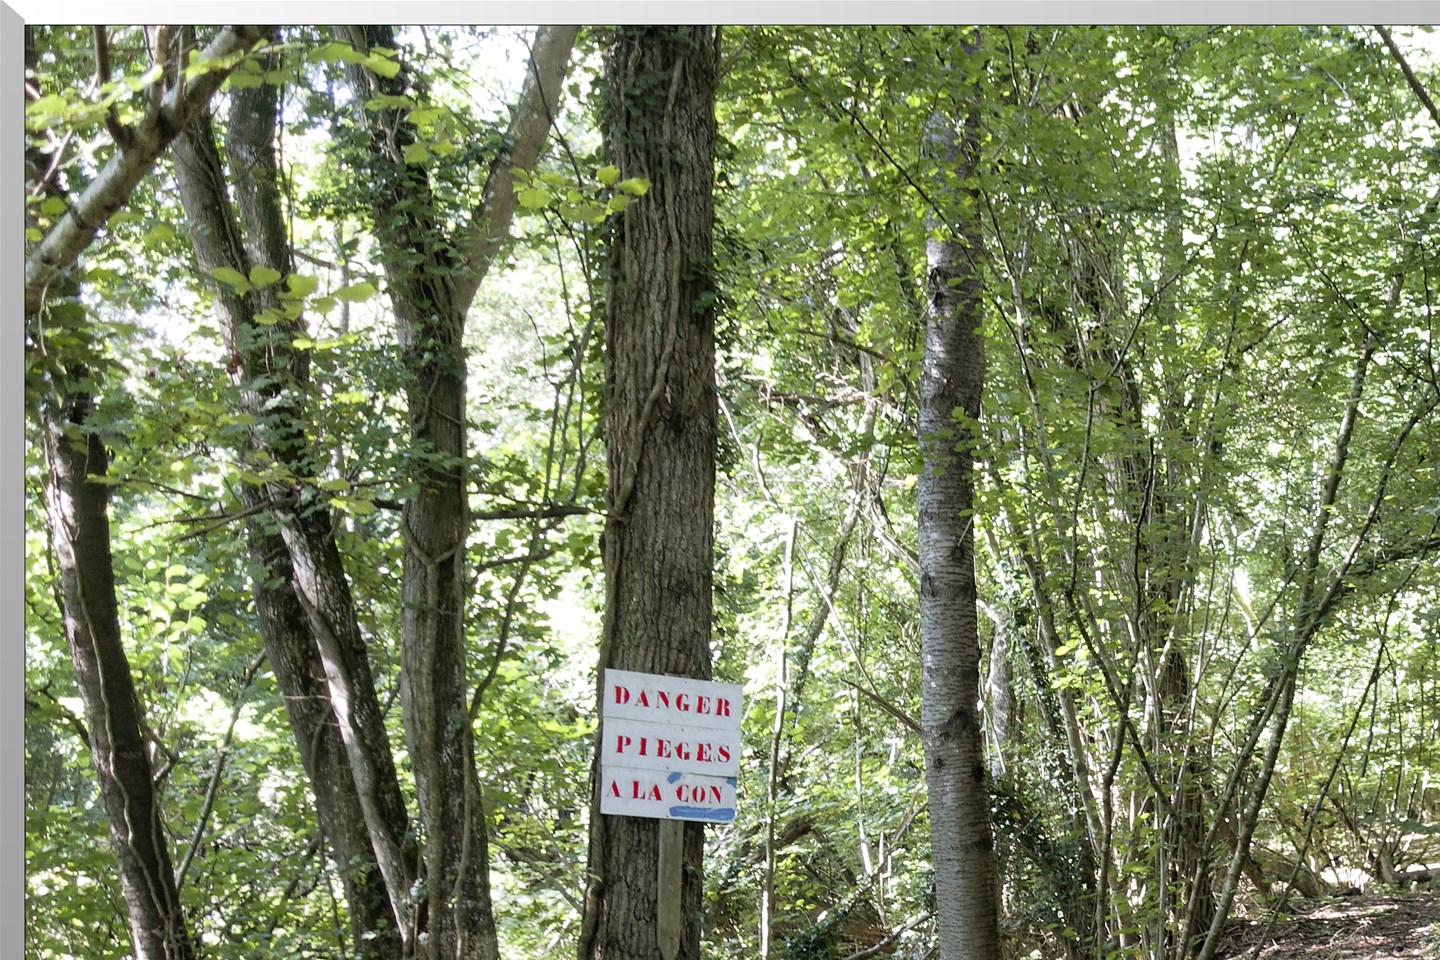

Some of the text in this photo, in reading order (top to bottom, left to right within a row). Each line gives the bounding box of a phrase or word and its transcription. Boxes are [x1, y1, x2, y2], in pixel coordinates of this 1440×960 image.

[614, 685, 731, 717] DANGER
[616, 735, 731, 763] PIEGES
[607, 780, 722, 804] A LA CON
